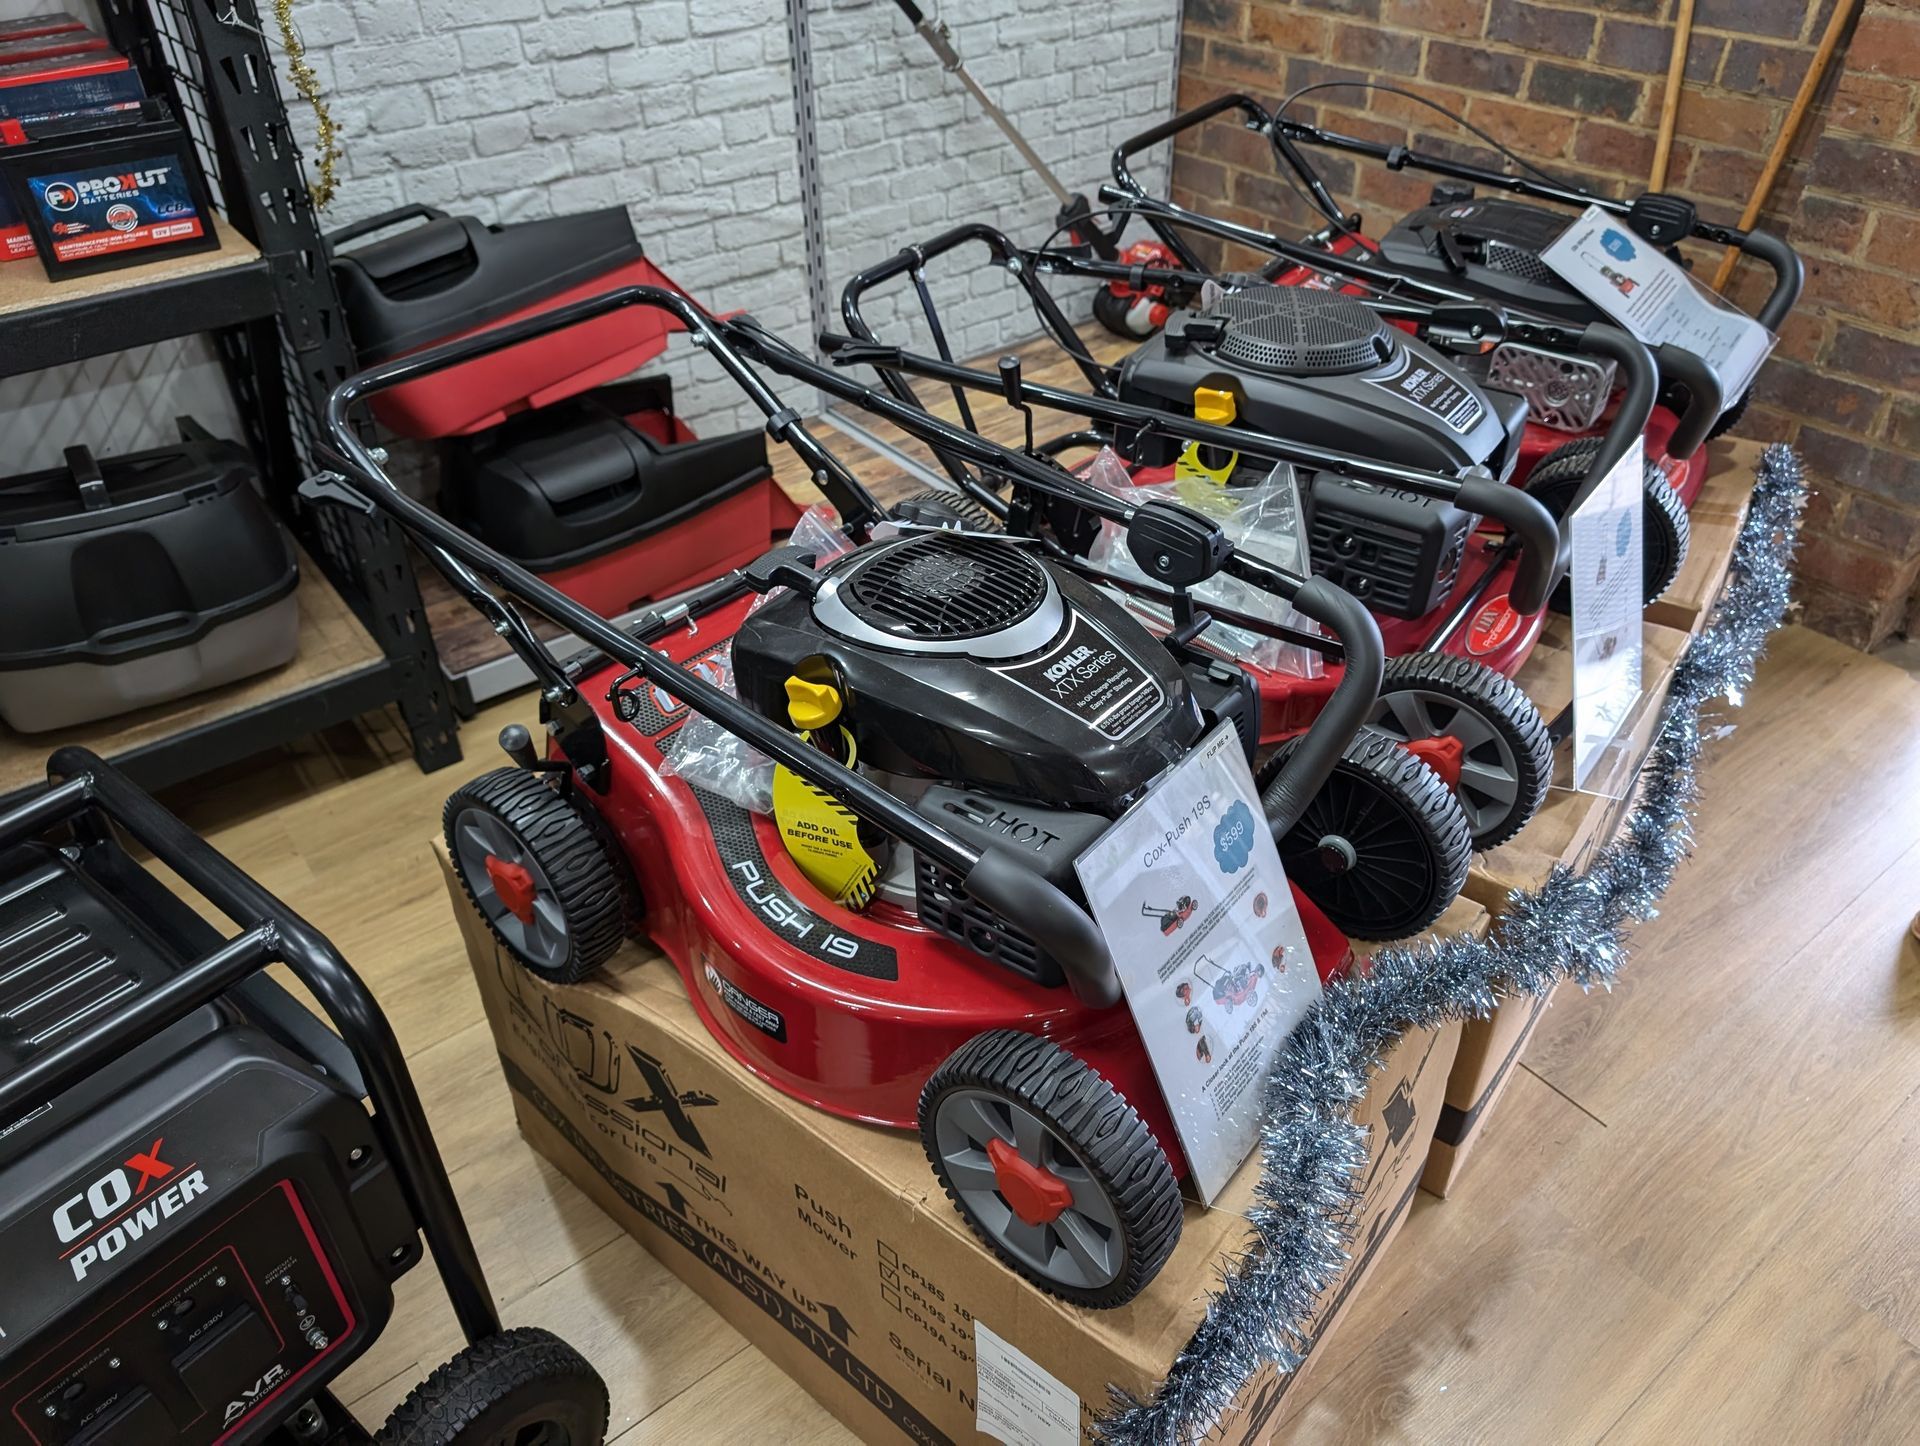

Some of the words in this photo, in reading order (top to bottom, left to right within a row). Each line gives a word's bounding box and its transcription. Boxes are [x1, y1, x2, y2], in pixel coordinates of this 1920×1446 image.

[77, 168, 169, 198] PROKUT
[82, 190, 140, 205] BATTERIES
[1043, 645, 1094, 682] KOHLER
[1049, 673, 1085, 699] XTX
[1077, 650, 1117, 678] Series
[1206, 745, 1217, 759] FLIP
[1216, 738, 1225, 749] ME
[787, 828, 829, 844] BEFORE
[831, 838, 854, 850] USE
[797, 820, 819, 832] ADD
[821, 826, 840, 837] OIL
[988, 811, 1060, 851] HOT
[1143, 816, 1192, 868] Cox-Push
[1191, 795, 1211, 820] 19S
[1220, 821, 1244, 852] $599
[732, 859, 814, 938] PUSH
[819, 933, 860, 959] 19
[722, 979, 780, 1025] DANGER
[622, 1134, 657, 1166] Life
[52, 1137, 175, 1243] COX
[70, 1169, 209, 1283] POWER
[794, 1183, 852, 1239] Push
[797, 1207, 858, 1261] Mower
[264, 1255, 293, 1279] CIRCUIT
[264, 1258, 297, 1286] BREAKER
[691, 1211, 739, 1254] THIS
[742, 1248, 786, 1290] WAY
[792, 1287, 819, 1314] UP
[902, 1263, 945, 1302] CP18S
[151, 1293, 182, 1318] CIRCUIT
[183, 1265, 219, 1294] BREAKER
[903, 1285, 946, 1324] CP19S
[188, 1328, 201, 1342] AC
[203, 1310, 224, 1331] 230V
[703, 1243, 782, 1318] (AUST)
[791, 1312, 835, 1358] PTY
[845, 1357, 894, 1410] LTD
[905, 1307, 947, 1347] CP19A
[37, 1376, 71, 1404] CIRCUIT
[72, 1347, 111, 1378] BREAKER
[248, 1369, 292, 1408] AUTOMATIC
[888, 1331, 951, 1393] Serial
[959, 1388, 975, 1412] N
[80, 1413, 94, 1427] AC
[95, 1393, 118, 1414] 230V
[222, 1363, 284, 1422] AVR
